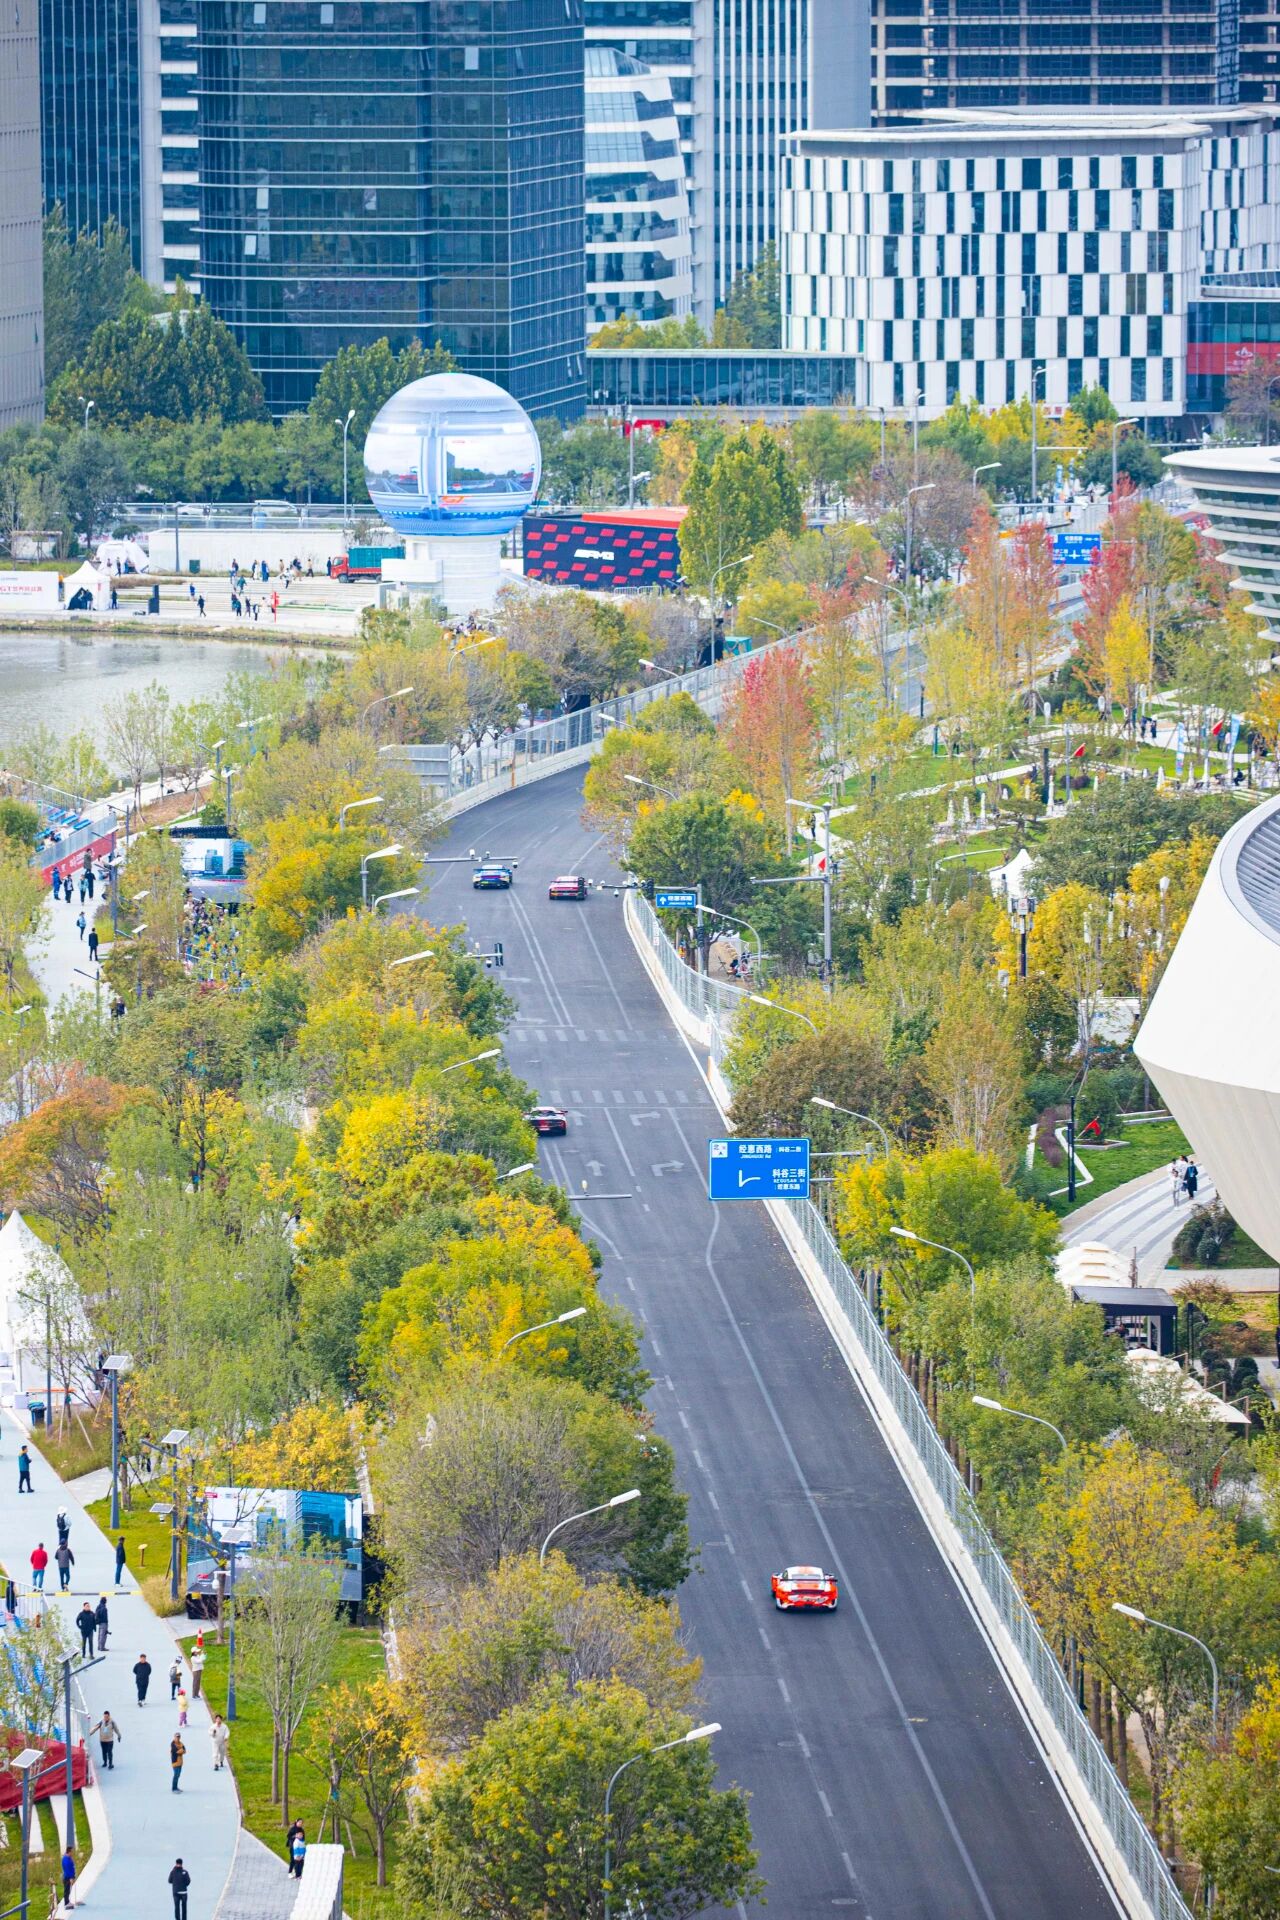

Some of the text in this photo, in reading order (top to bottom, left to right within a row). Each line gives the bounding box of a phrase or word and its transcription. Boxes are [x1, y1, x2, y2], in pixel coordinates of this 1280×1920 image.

[739, 1144, 772, 1153] 经惠西路
[772, 1168, 806, 1178] 科谷三街
